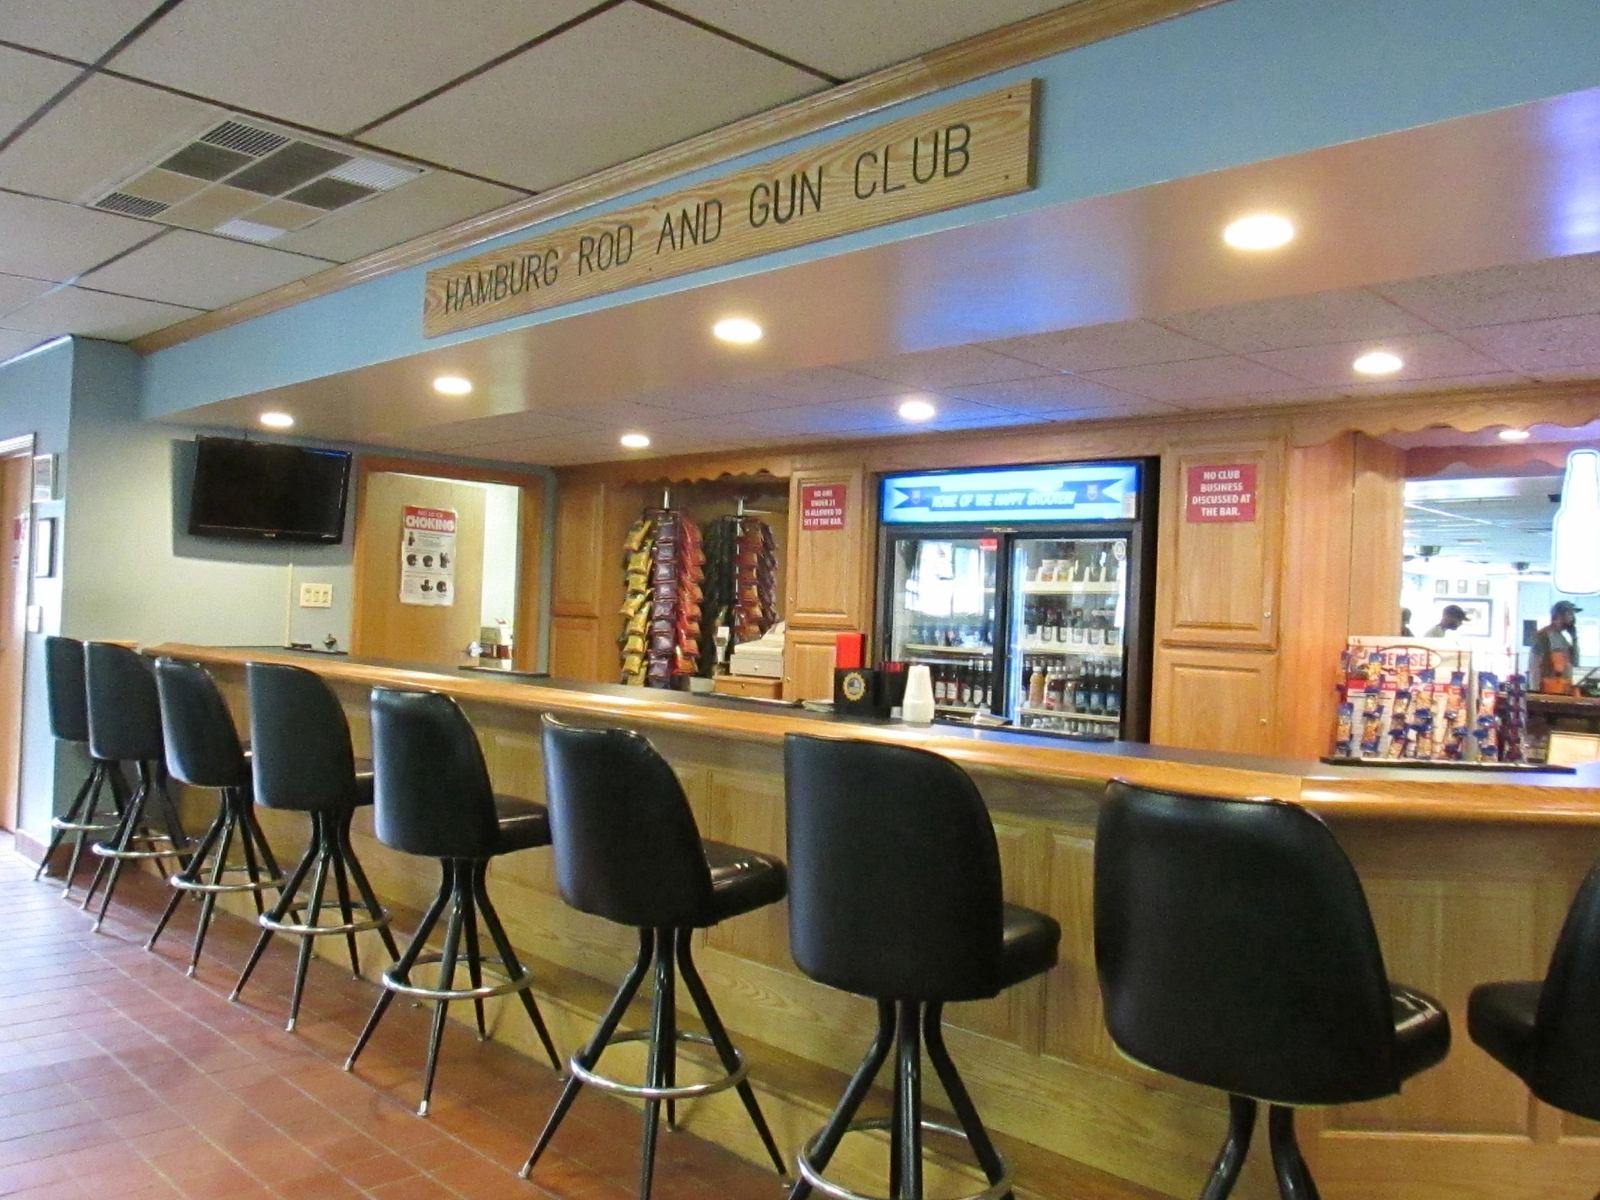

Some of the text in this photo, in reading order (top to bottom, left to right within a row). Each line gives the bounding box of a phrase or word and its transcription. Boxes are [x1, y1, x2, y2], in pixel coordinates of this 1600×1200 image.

[445, 122, 971, 314] HAMBURG ROD AND GUN CLUB
[1203, 470, 1240, 480] NO CLUB
[1200, 482, 1243, 492] BUSINESS
[1192, 494, 1251, 504] DISCUSSED AT
[1201, 507, 1240, 516] THE BAR.
[405, 515, 454, 531] CHOKING
